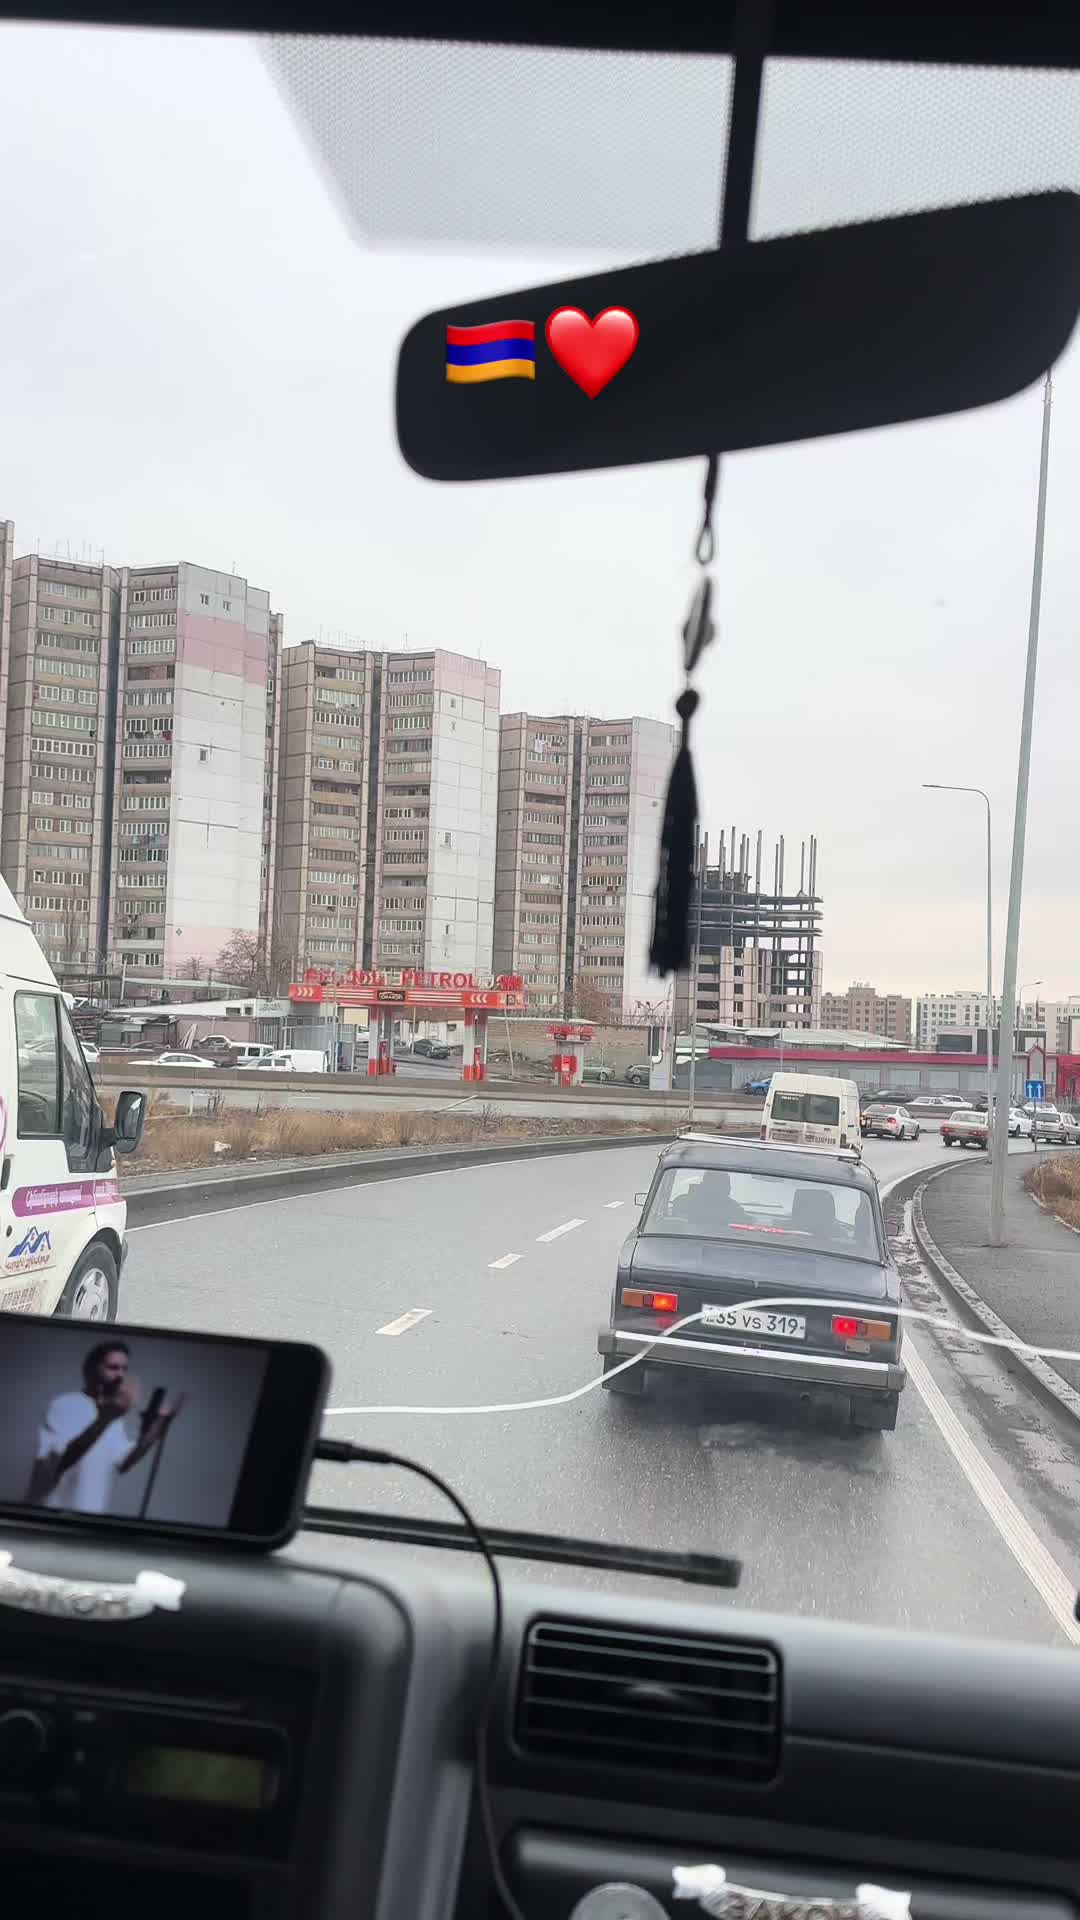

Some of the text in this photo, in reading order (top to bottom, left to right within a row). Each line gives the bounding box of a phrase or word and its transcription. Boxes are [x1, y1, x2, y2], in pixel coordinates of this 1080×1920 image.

[401, 969, 481, 988] PETROL
[742, 1314, 761, 1330] VS
[766, 1314, 798, 1334] 319
